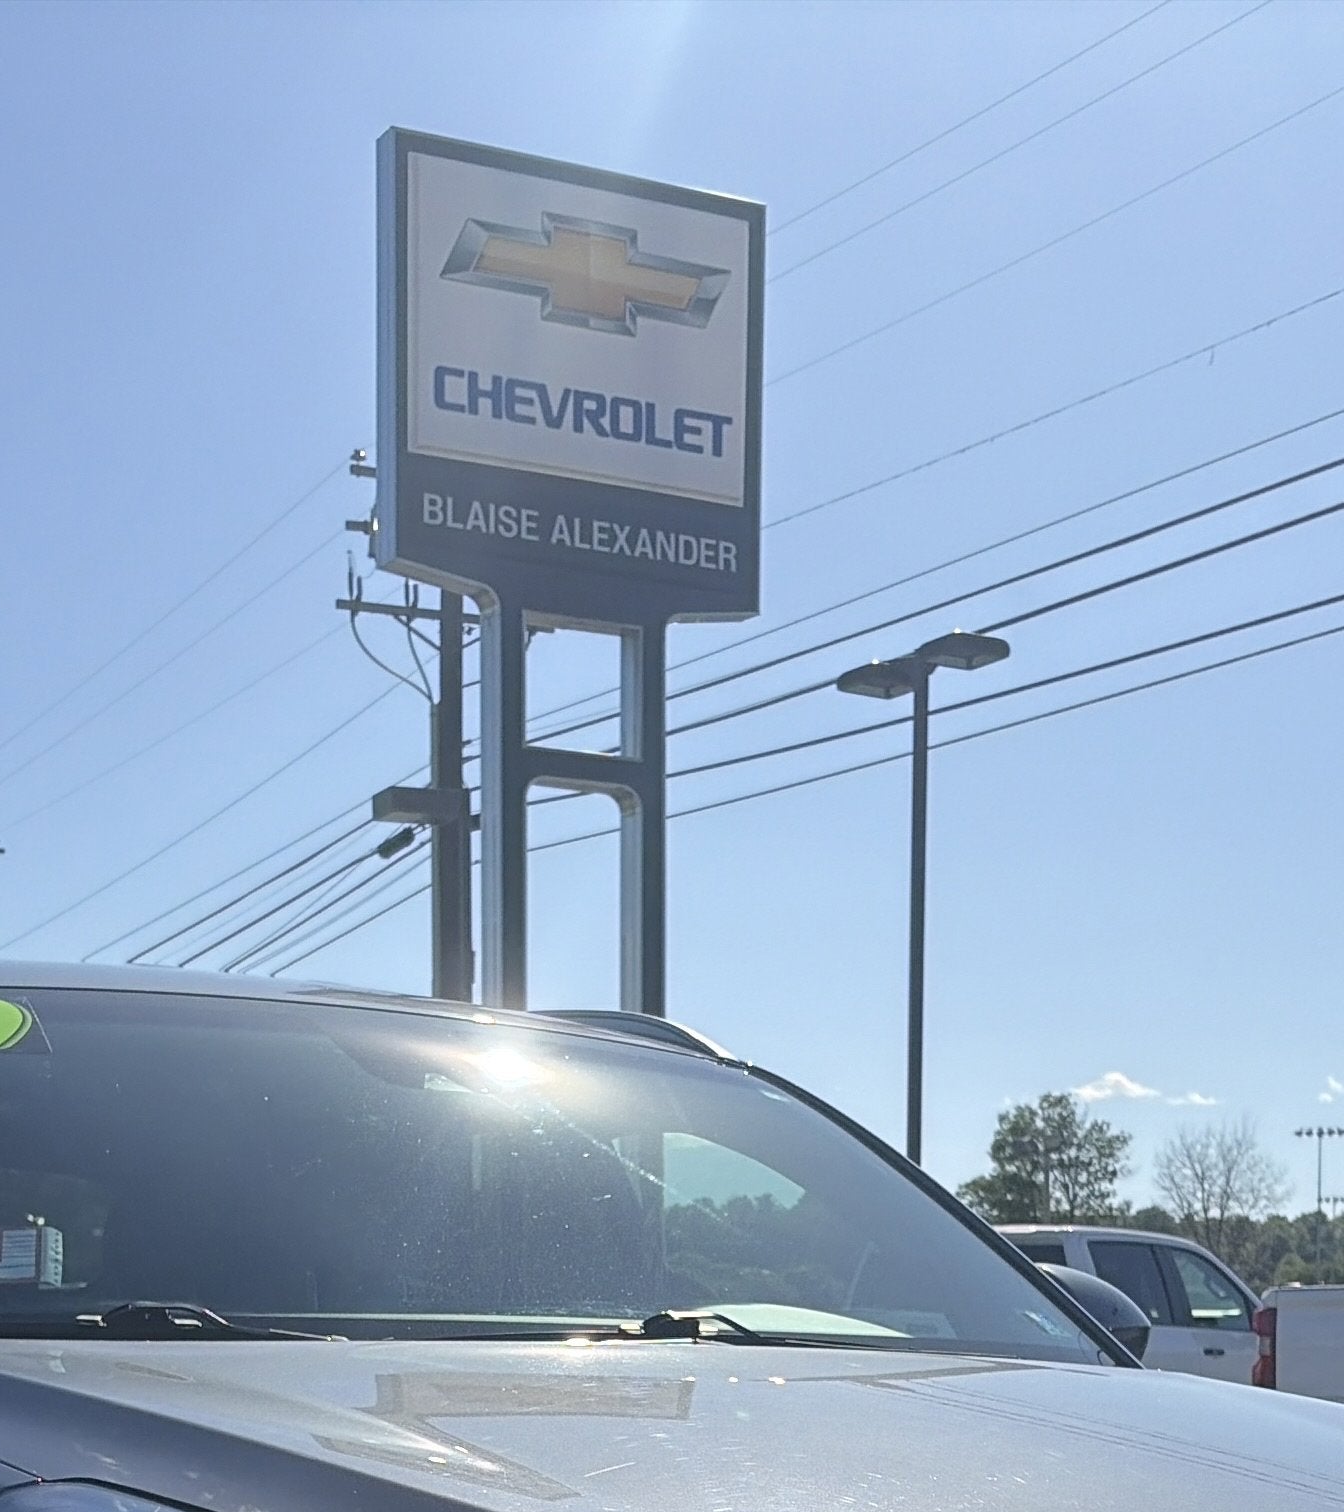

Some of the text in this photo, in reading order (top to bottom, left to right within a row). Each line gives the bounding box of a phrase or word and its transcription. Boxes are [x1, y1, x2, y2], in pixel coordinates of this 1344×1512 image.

[433, 365, 733, 458] CHEVROLET
[422, 492, 737, 572] BLAISE ALEXANDER
